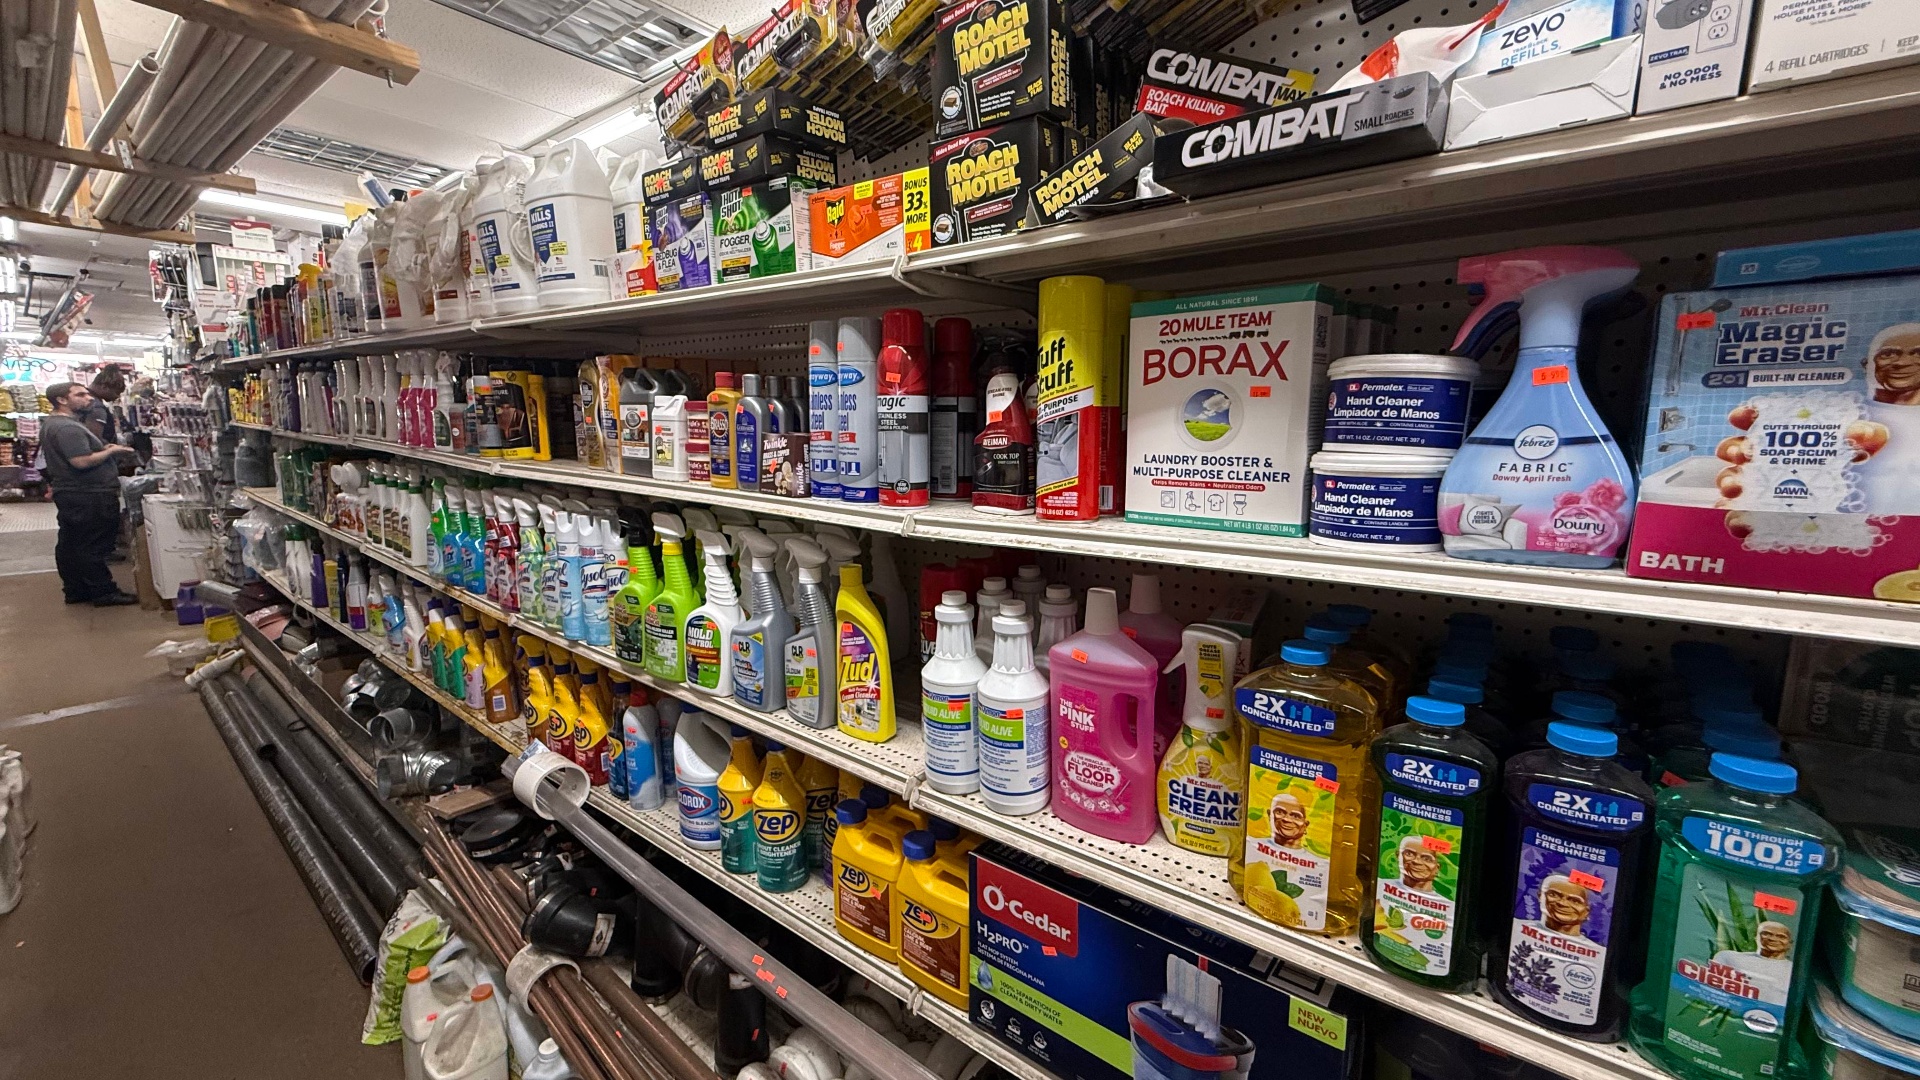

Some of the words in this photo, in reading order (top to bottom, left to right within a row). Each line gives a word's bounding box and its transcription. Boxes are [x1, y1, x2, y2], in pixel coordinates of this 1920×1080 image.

[1774, 10, 1804, 20] HOUSE
[1807, 2, 1835, 13] FLIES,
[954, 2, 1029, 54] ROACH
[1500, 12, 1565, 50] zevo
[959, 27, 1031, 76] MOTEL
[1501, 40, 1559, 67] REFILLS
[1764, 60, 1774, 73] 4
[1778, 56, 1806, 72] REFILL
[1809, 44, 1869, 65] CARTRIDGES
[1051, 28, 1060, 107] ROACH
[1058, 35, 1066, 108] MOTEL
[1146, 48, 1296, 107] COMBAT
[1273, 86, 1306, 102] MAX
[1663, 72, 1680, 82] NO
[1684, 63, 1720, 78] ODOR
[1659, 82, 1666, 90] &
[1669, 78, 1686, 88] NO
[1690, 70, 1722, 83] MESS
[1146, 89, 1184, 106] ROACH
[1185, 97, 1226, 116] KILLING
[709, 119, 744, 139] MOTEL
[807, 110, 845, 131] MOTEL
[1181, 90, 1370, 168] COMBAT
[1354, 115, 1384, 132] SMALL
[1384, 108, 1415, 121] ROACHES
[806, 121, 846, 144] ROACH
[800, 155, 834, 170] MOTEL
[946, 144, 1020, 186] ROACH
[904, 177, 928, 190] BONUS
[951, 166, 1021, 206] MOTEL
[1035, 148, 1103, 204] ROACH
[721, 188, 740, 206] HOT
[905, 190, 928, 212] 33%
[1042, 168, 1108, 218] MOTEL
[530, 208, 552, 224] KILLS
[720, 198, 743, 219] SHOT
[826, 199, 844, 224] Raid
[906, 212, 928, 226] MORE
[720, 234, 750, 248] FOGGER
[656, 249, 678, 262] BEDBUG
[1176, 302, 1188, 310] ALL
[1189, 298, 1220, 309] NATURAL
[1221, 297, 1242, 306] SINCE
[1243, 295, 1258, 304] 1891
[1158, 318, 1181, 338] 20
[1182, 314, 1226, 332] MULE
[1228, 310, 1272, 328] TEAM
[1720, 315, 1846, 344] Magic
[1142, 340, 1291, 386] BORAX
[1717, 344, 1845, 364] Eraser
[1346, 396, 1373, 406] Hand
[1375, 396, 1424, 406] Cleaner
[710, 417, 728, 431] BRASSO
[1334, 408, 1380, 419] Limpiador
[1382, 409, 1398, 418] de
[1400, 410, 1440, 420] Manos
[763, 436, 788, 450] Twinkle
[982, 436, 1008, 447] WEIMAN
[1518, 434, 1555, 448] febreze
[993, 452, 1008, 460] COOK
[1009, 452, 1020, 460] TOP
[1144, 454, 1198, 466] LAUNDRY
[1201, 456, 1260, 468] BOOSTER
[1264, 458, 1273, 468] &
[1760, 449, 1795, 457] SOAP
[1796, 449, 1838, 458] SCUM
[1782, 458, 1827, 466] GRIME
[1133, 466, 1224, 480] MULTI-PURPOSE
[1226, 470, 1290, 483] CLEANER
[1498, 462, 1568, 473] FABRIC
[796, 462, 804, 496] Twinkle
[1168, 480, 1188, 488] Remove
[1212, 482, 1244, 490] Neutralizes
[1492, 473, 1521, 483] Downy
[1523, 474, 1544, 483] April
[1547, 474, 1572, 482] Fresh
[1324, 492, 1348, 503] Hand
[1350, 494, 1396, 506] Cleaner
[1774, 486, 1809, 496] DAWN
[1314, 502, 1354, 516] Limpiador
[1356, 506, 1372, 516] de
[1374, 507, 1414, 518] Manos
[1554, 518, 1606, 534] Downy
[1639, 551, 1725, 574] BATH
[581, 566, 607, 590] Lysol
[688, 626, 714, 640] MOLD
[688, 638, 714, 648] CONTROL
[739, 642, 750, 652] CLR
[792, 640, 804, 653] CLR
[842, 652, 876, 683] Zud
[1060, 698, 1072, 708] THE
[1254, 692, 1287, 718] 2X
[1060, 704, 1094, 727] PINK
[1241, 704, 1322, 732] CONCENTRATED
[991, 726, 1014, 737] ALIVE
[1070, 721, 1094, 733] STUFF
[1070, 757, 1081, 766] ALL
[1082, 761, 1110, 772] PURPOSE
[1260, 751, 1283, 762] LONG
[1284, 758, 1324, 772] LASTING
[1260, 758, 1323, 778] FRESHNESS
[1402, 759, 1435, 778] 2X
[1068, 762, 1115, 785] FLOOR
[1076, 776, 1104, 788] CLEANER
[1392, 769, 1466, 791] CONCENTRATED
[677, 792, 706, 808] CLOROX
[1168, 780, 1240, 806] CLEAN
[1552, 790, 1592, 813] 2X
[1168, 794, 1239, 820] FREAK
[1392, 802, 1452, 822] FRESHNESS
[1394, 796, 1416, 808] LONG
[1416, 802, 1452, 816] LASTING
[1537, 801, 1628, 826] CONCENTRATED
[757, 814, 794, 835] Zep
[1168, 808, 1212, 824] MULTI-PURPOSE
[1212, 820, 1240, 828] CLEANER
[1536, 832, 1562, 846] LONG
[1564, 839, 1607, 856] LASTING
[1708, 820, 1741, 836] CUTS
[1742, 828, 1804, 848] THROUGH
[1535, 838, 1606, 863] FRESHNESS
[841, 863, 866, 887] Zep
[1270, 860, 1297, 872] LEMON
[983, 884, 1072, 942] O-Cedar
[1410, 916, 1447, 931] Gain
[978, 941, 988, 950] FLAT
[988, 946, 1000, 956] MOP
[1000, 952, 1019, 966] SYSTEM
[1533, 942, 1580, 962] LAVENDER
[1566, 968, 1594, 982] febreze
[1676, 958, 1760, 1000] Clean
[1708, 960, 1752, 984] Mr.
[1000, 980, 1016, 992] 100%
[1016, 988, 1052, 1012] SEPARATION
[1053, 1008, 1061, 1016] OF
[1298, 1008, 1325, 1026] NEW
[1297, 1018, 1338, 1040] NUEVO
